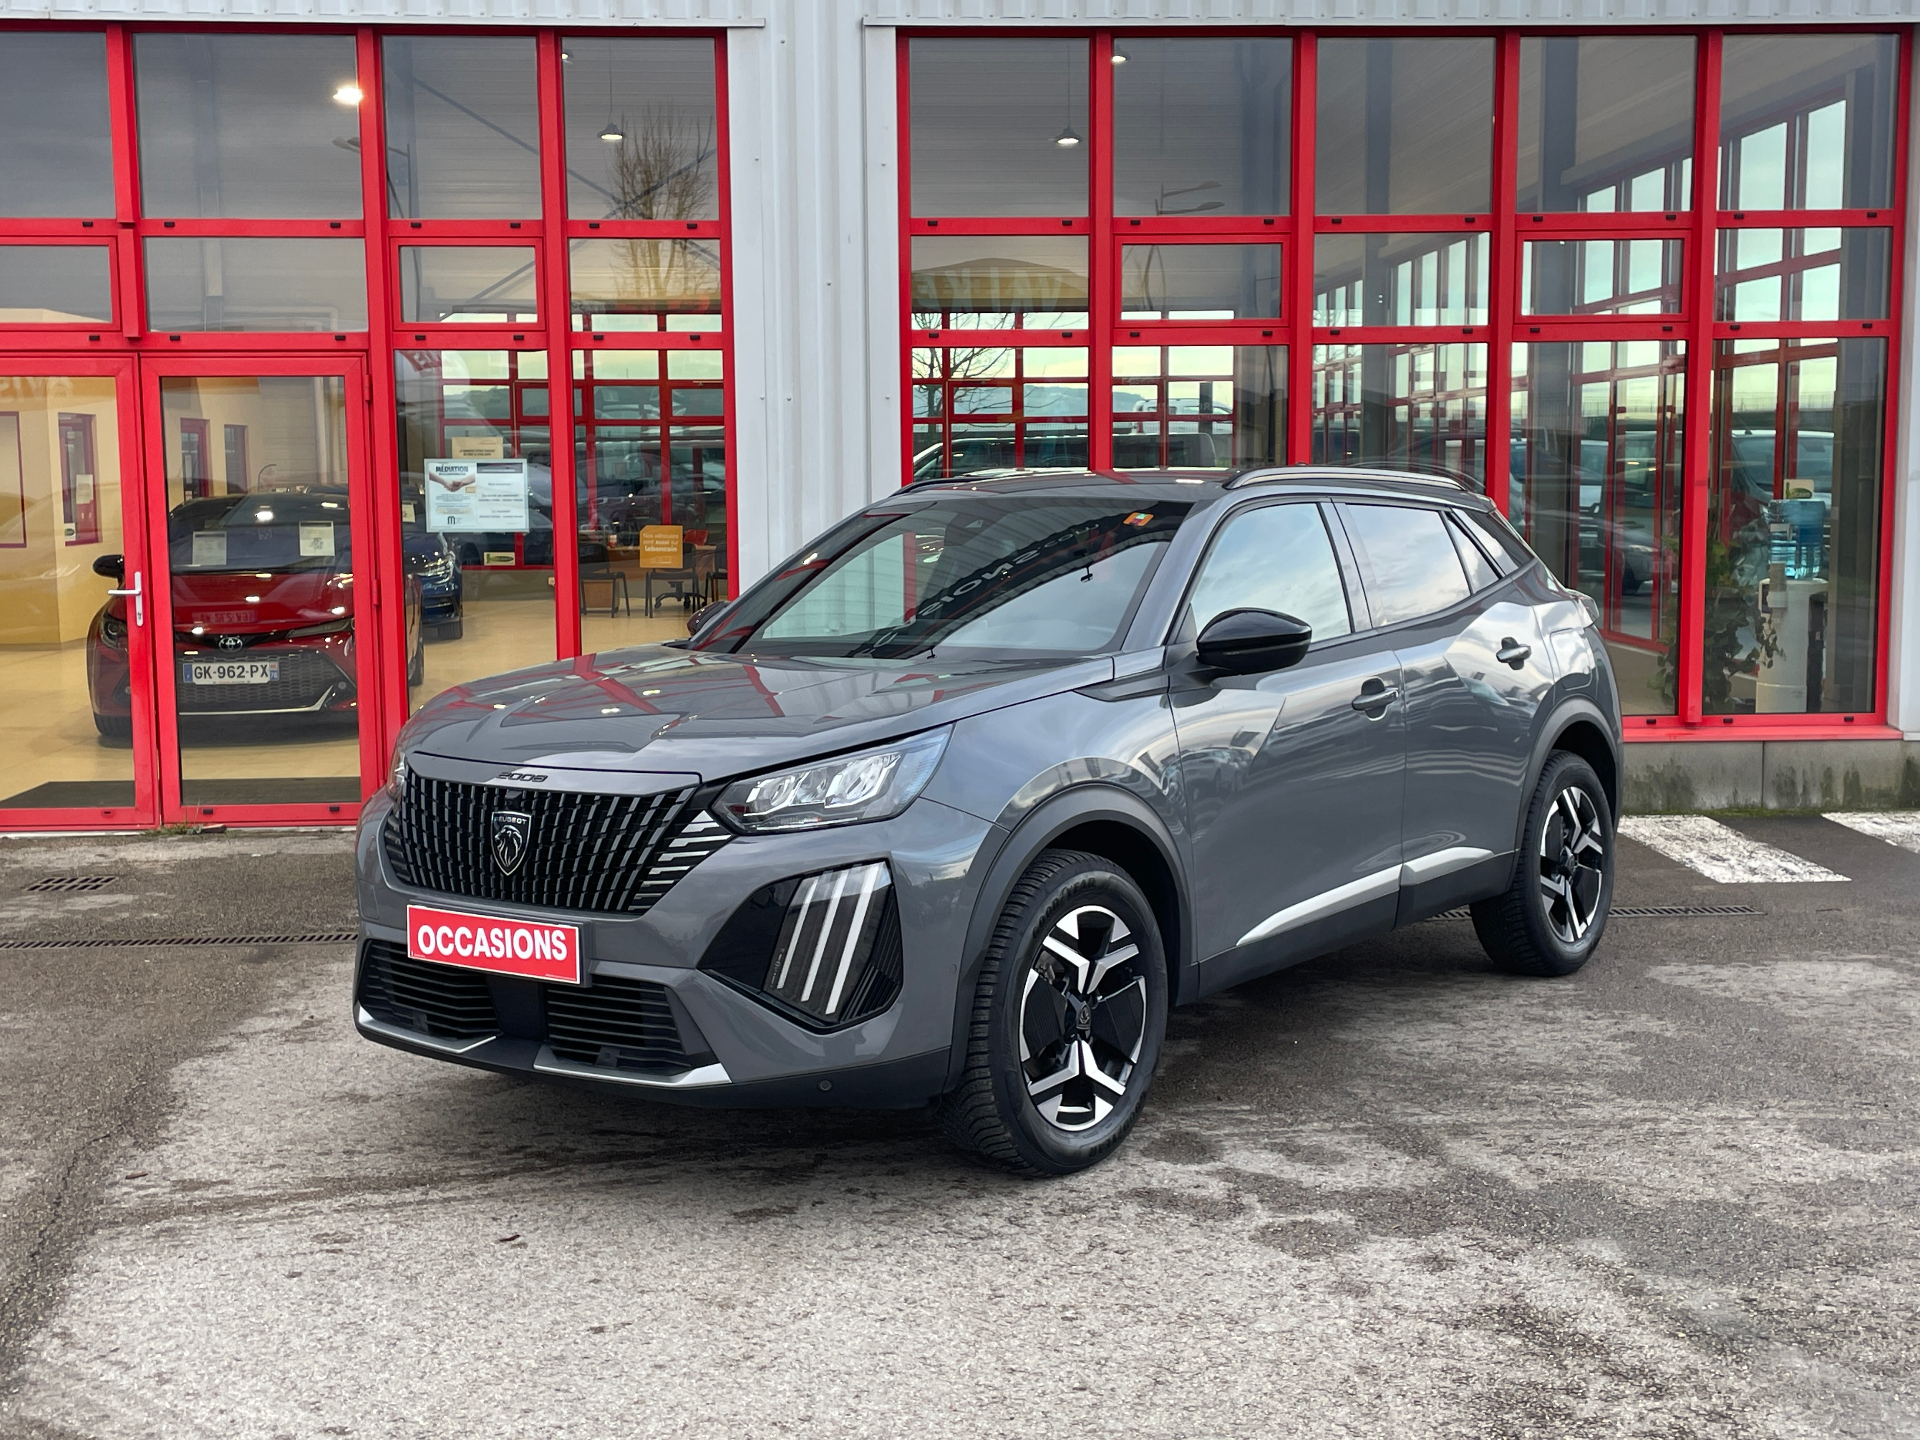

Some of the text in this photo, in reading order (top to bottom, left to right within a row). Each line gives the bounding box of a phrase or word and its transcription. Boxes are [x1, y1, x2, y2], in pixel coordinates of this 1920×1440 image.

[194, 664, 269, 680] GK-962-PX
[496, 771, 549, 783] 2008
[494, 815, 528, 825] PEUGEOT
[417, 924, 568, 961] OCCASIONS
